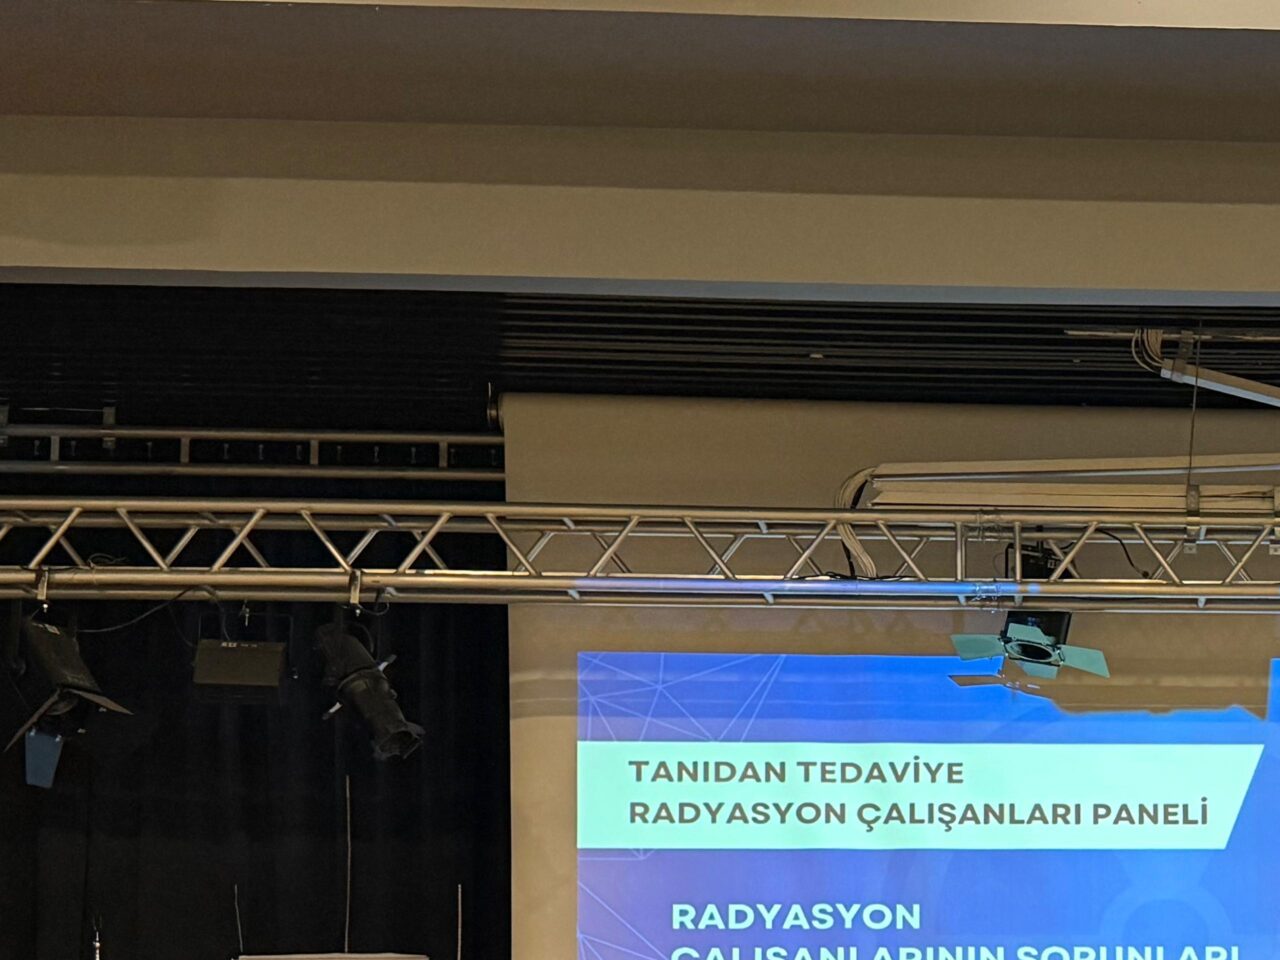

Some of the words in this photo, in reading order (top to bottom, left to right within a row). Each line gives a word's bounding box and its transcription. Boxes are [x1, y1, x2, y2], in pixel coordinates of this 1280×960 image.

[629, 760, 786, 784] TANIDAN
[798, 755, 964, 784] TEDAVİYE
[629, 802, 847, 825] RADYASYON
[857, 802, 1081, 831] ÇALIŞANLARI
[1092, 796, 1209, 826] PANELİ
[672, 903, 921, 930] RADYASYON
